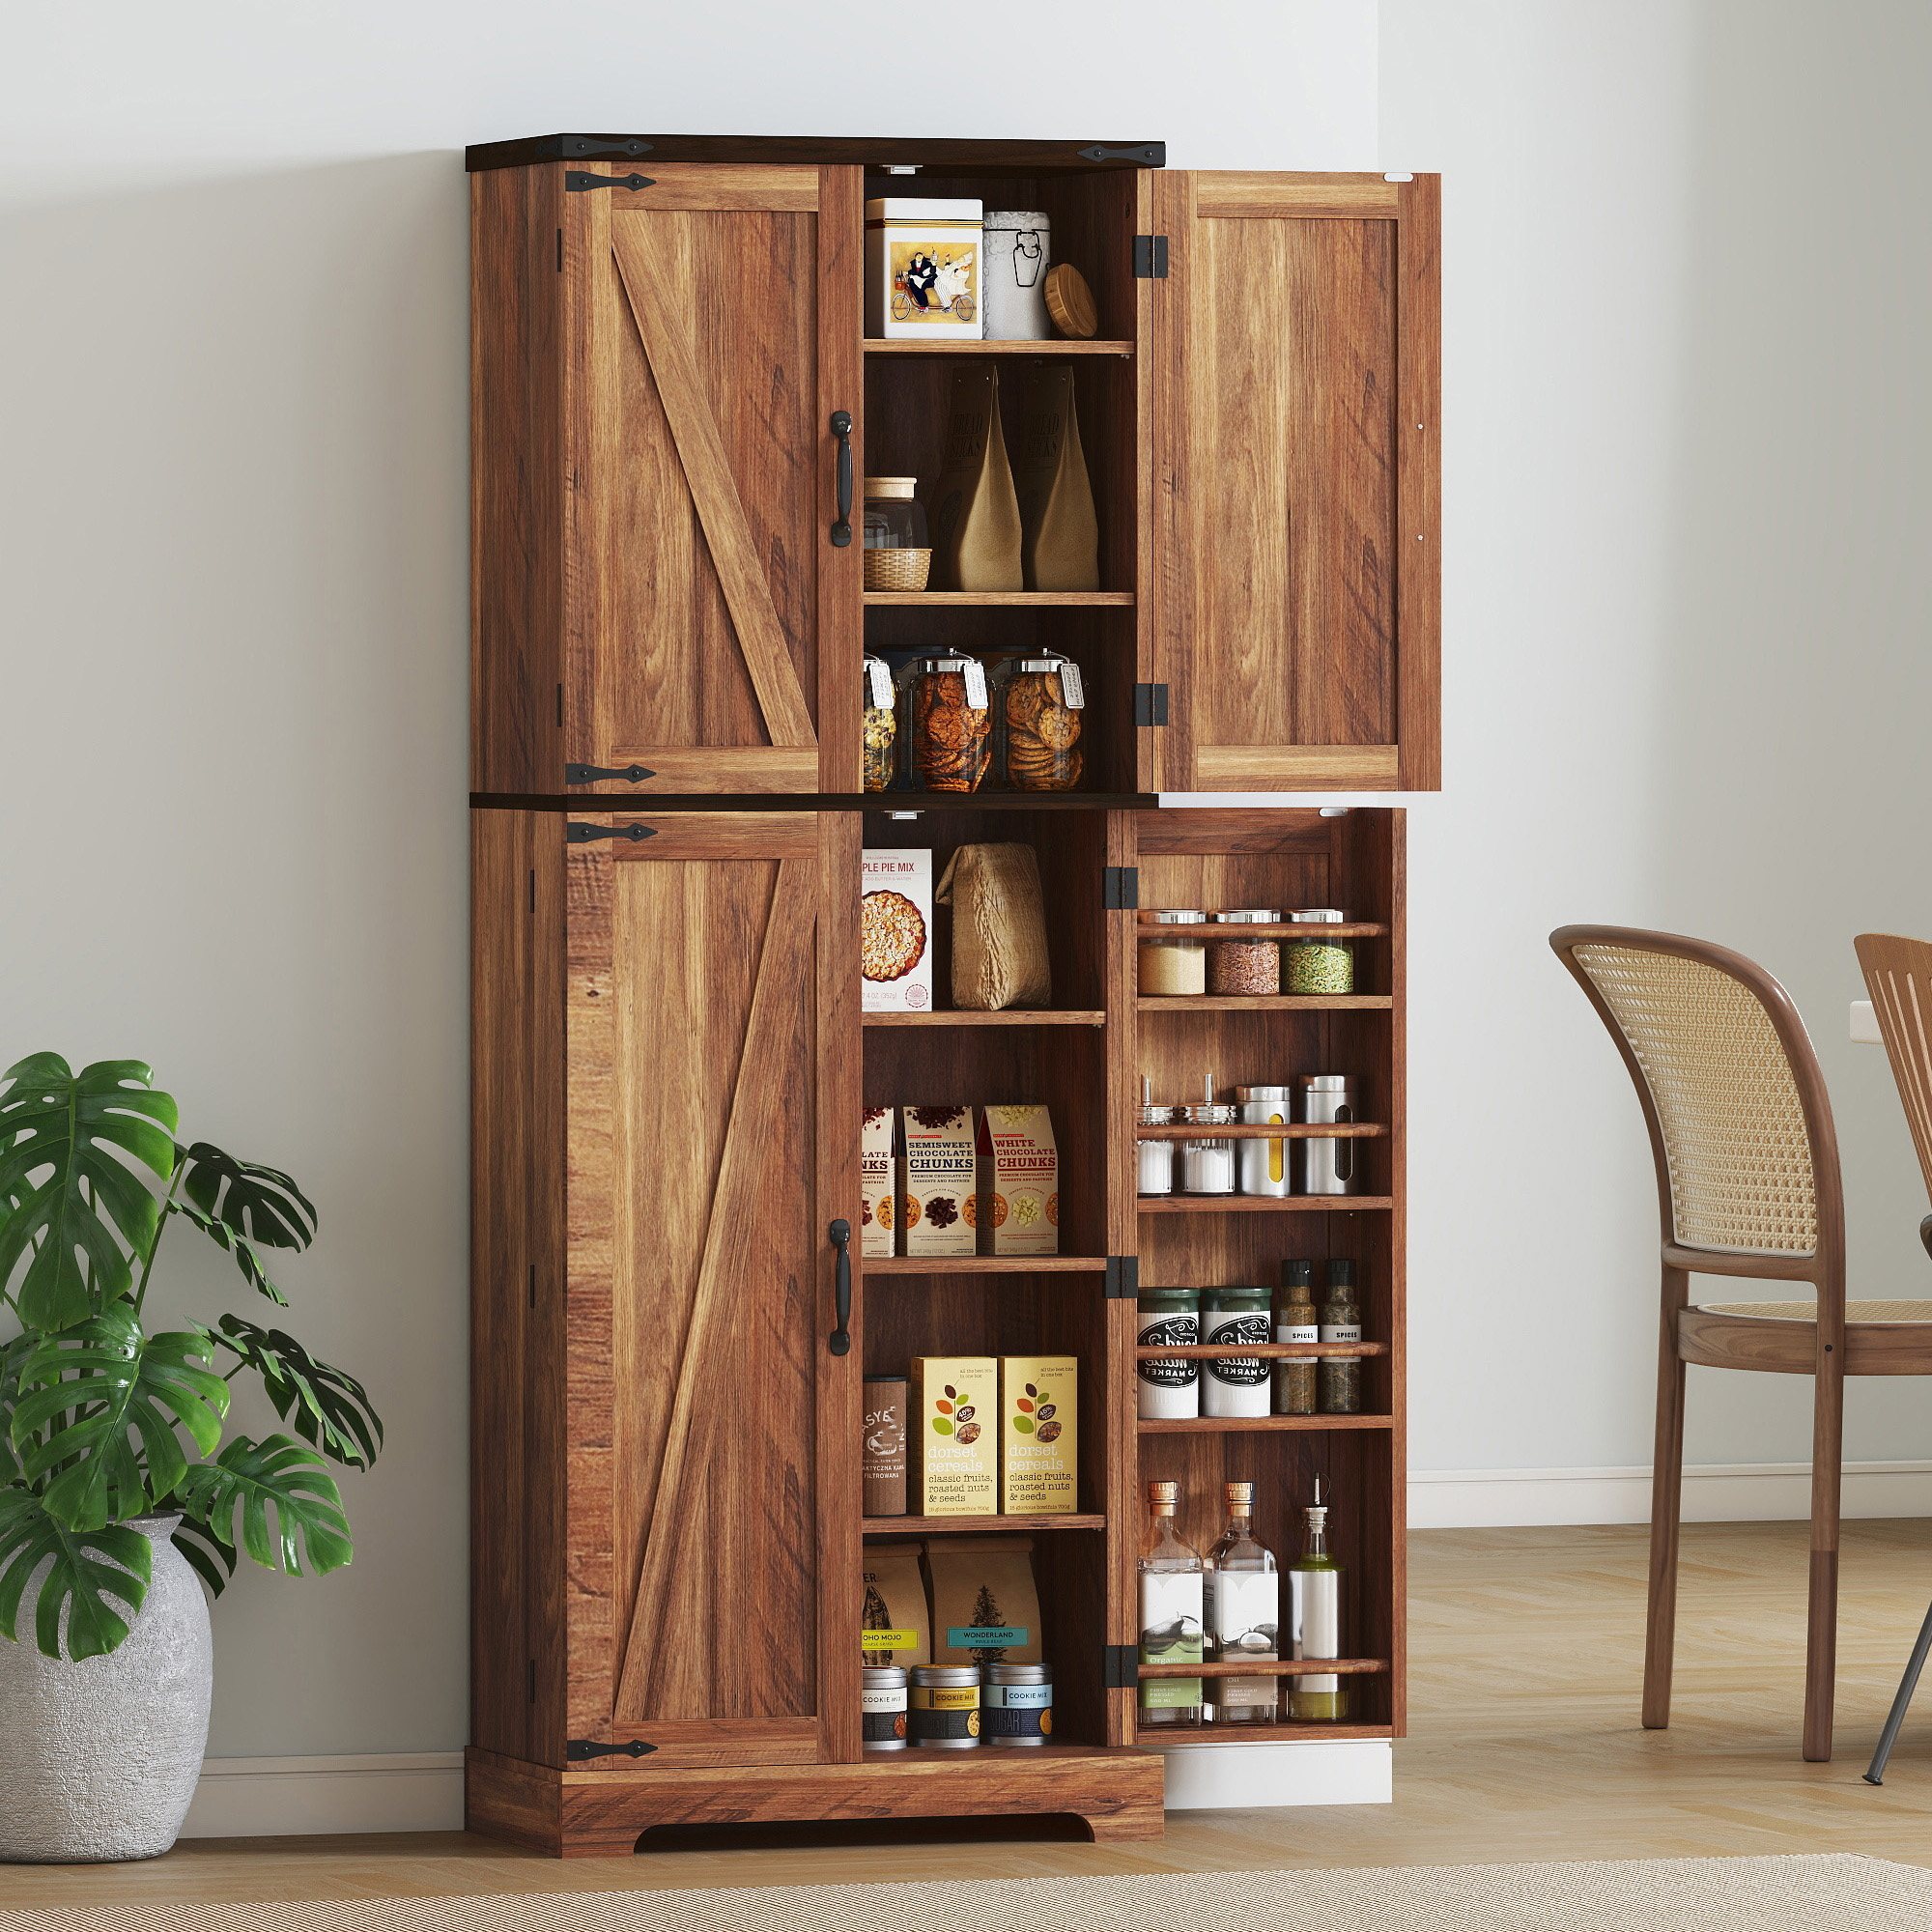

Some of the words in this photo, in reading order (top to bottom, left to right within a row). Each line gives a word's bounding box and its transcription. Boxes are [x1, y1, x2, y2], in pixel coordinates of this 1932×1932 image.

[881, 863, 895, 872] PIE
[897, 863, 915, 872] MIX
[994, 1139, 1036, 1148] WHITE
[909, 1158, 974, 1169] CHUNKS
[997, 1156, 1056, 1168] CHUNKS
[927, 1445, 978, 1459] dorset
[1009, 1444, 1058, 1457] dorset
[927, 1459, 983, 1472] cereals
[1009, 1457, 1064, 1471] cereals
[928, 1474, 961, 1483] classic
[963, 1473, 993, 1484] fruits,
[1009, 1472, 1042, 1482] classic
[1044, 1471, 1074, 1482] fruits,
[928, 1484, 965, 1493] roasted
[967, 1484, 990, 1492] nuts
[1009, 1482, 1046, 1492] roasted
[1047, 1482, 1070, 1491] nuts
[928, 1494, 937, 1503] &
[939, 1493, 966, 1503] seeds
[1009, 1492, 1018, 1501] &
[1019, 1492, 1047, 1501] seeds
[863, 1573, 877, 1583] ER
[1150, 1657, 1184, 1665] Organic
[990, 1709, 1020, 1732] SUGAR
